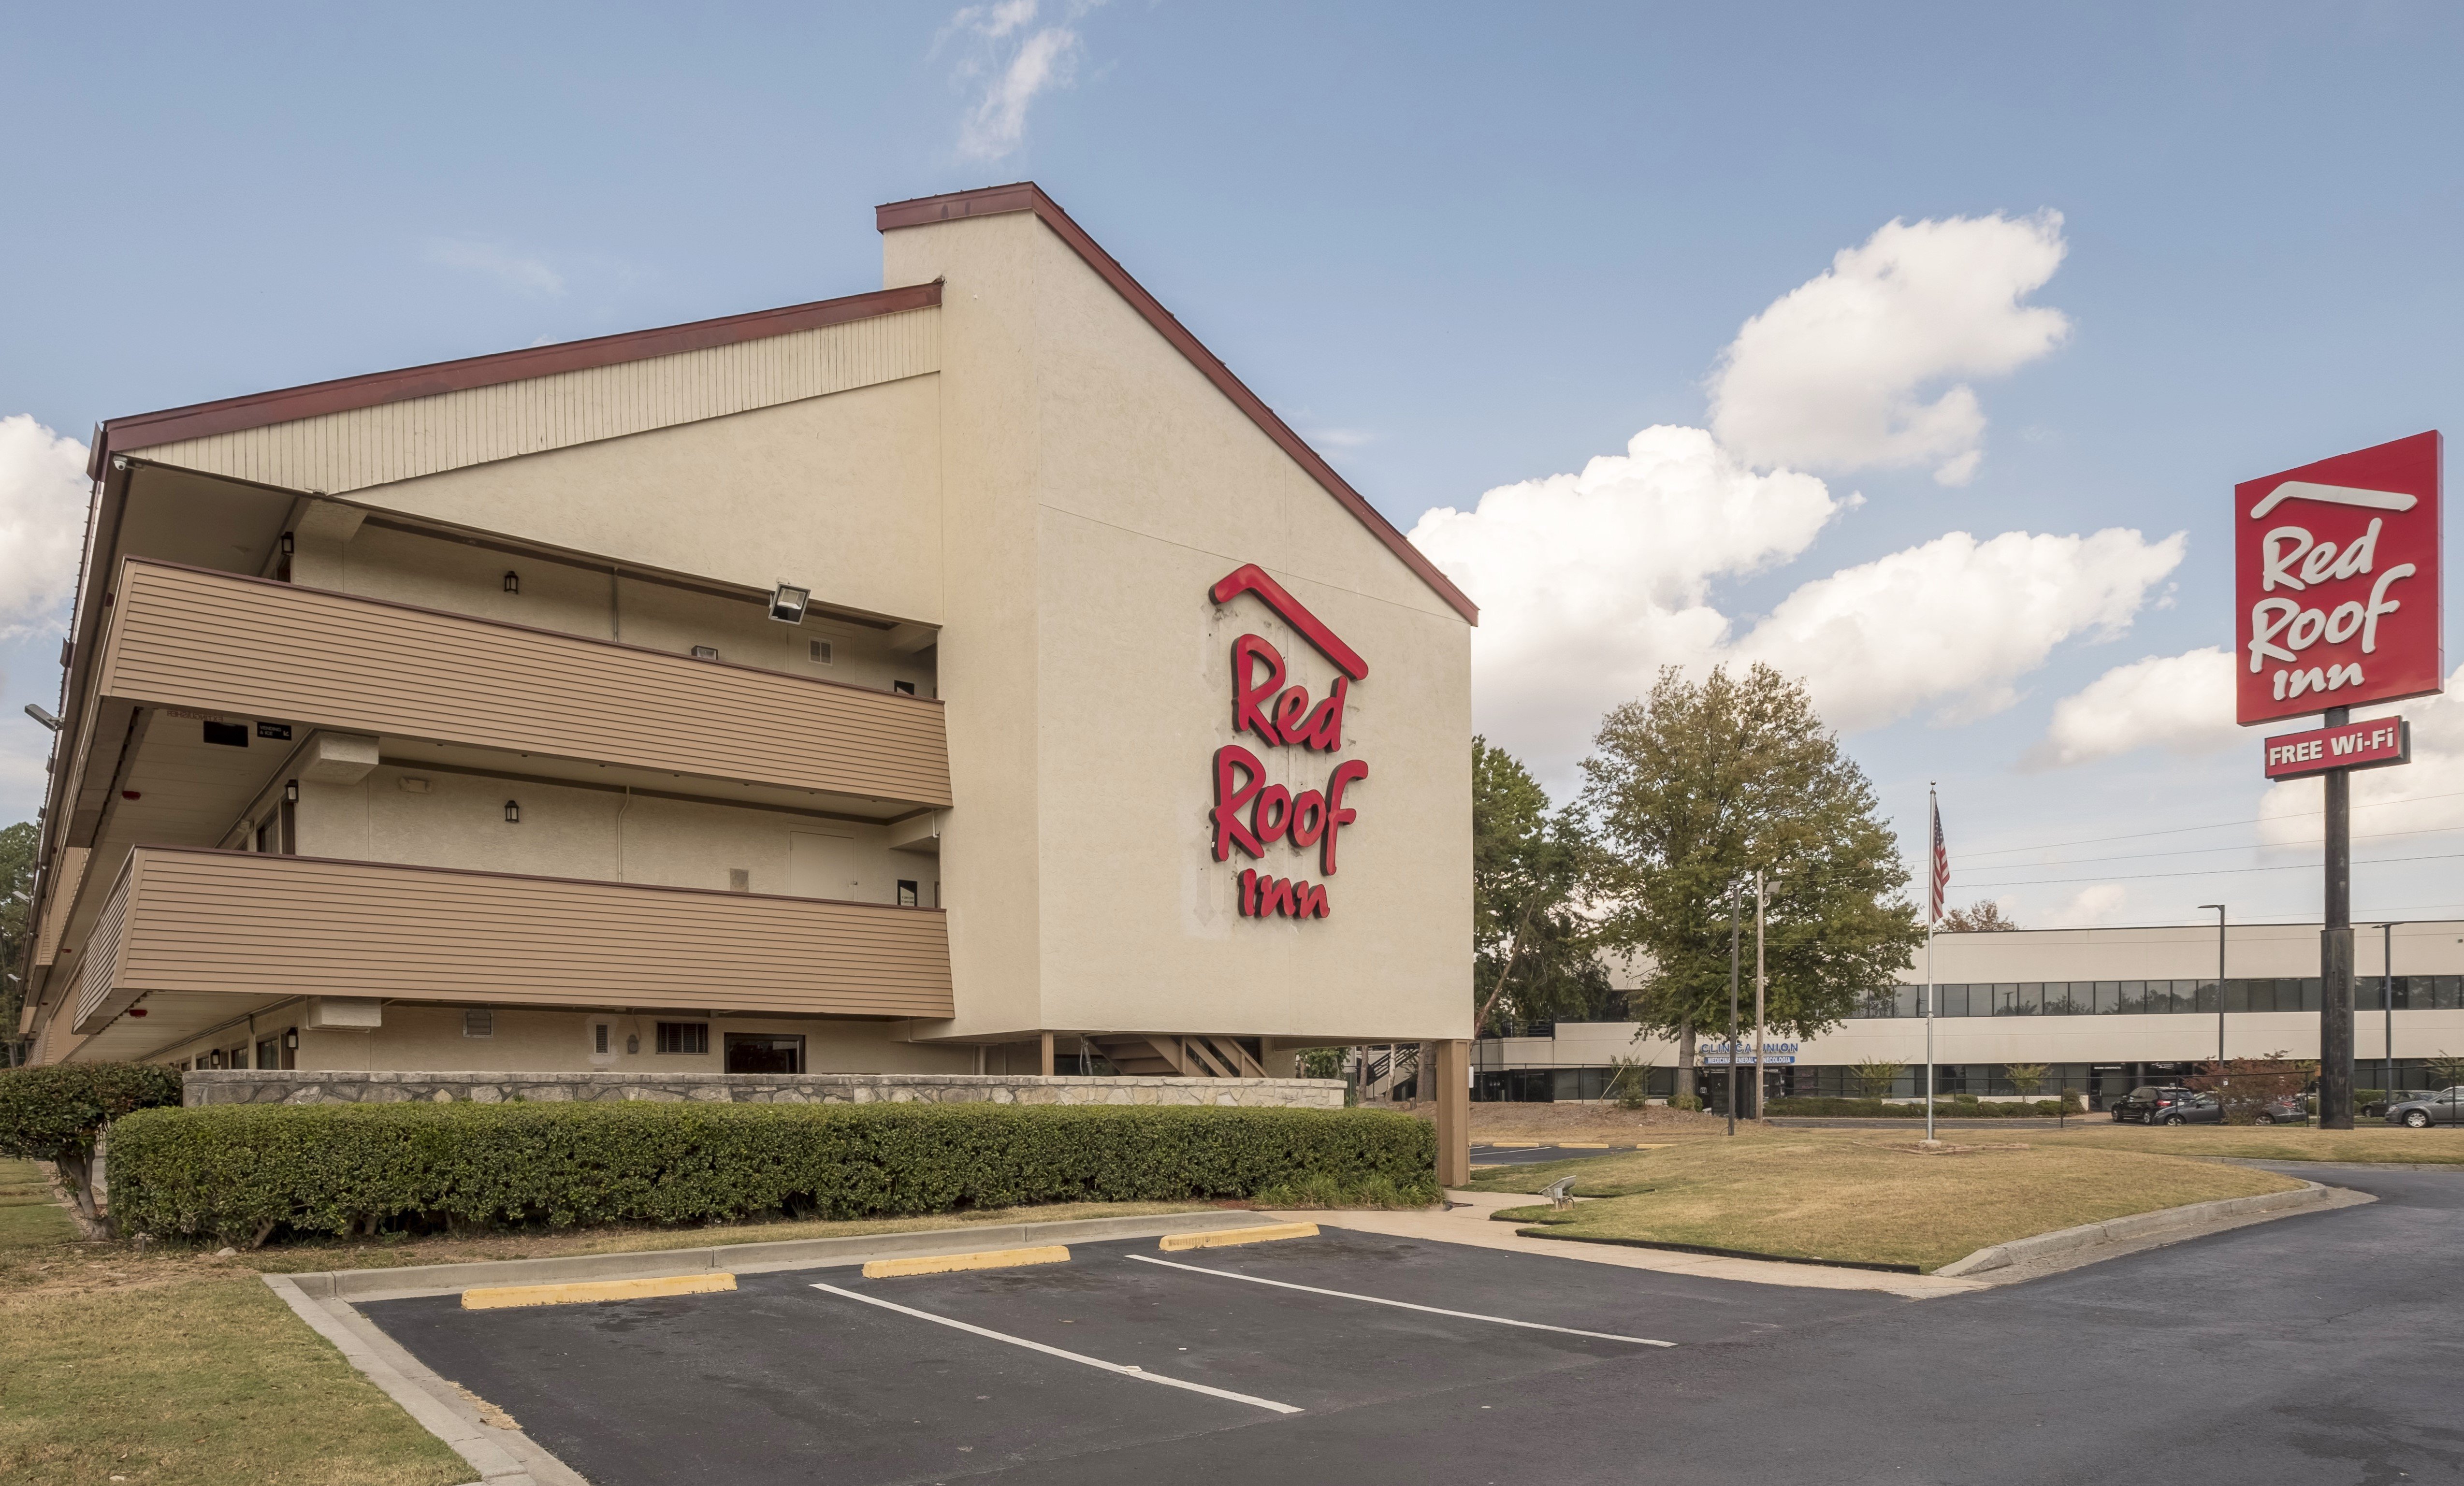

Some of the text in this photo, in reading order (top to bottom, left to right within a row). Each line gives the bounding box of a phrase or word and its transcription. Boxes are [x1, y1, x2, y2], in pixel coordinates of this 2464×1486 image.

[2262, 517, 2383, 592] Red
[2248, 563, 2417, 674] Roof
[1230, 633, 1348, 752] Red
[2273, 662, 2365, 701] inn
[2269, 727, 2394, 767] FREE Wi-Fi
[1209, 744, 1369, 876] Roof
[1238, 868, 1331, 919] inn
[1701, 1043, 1752, 1053] CLINCA
